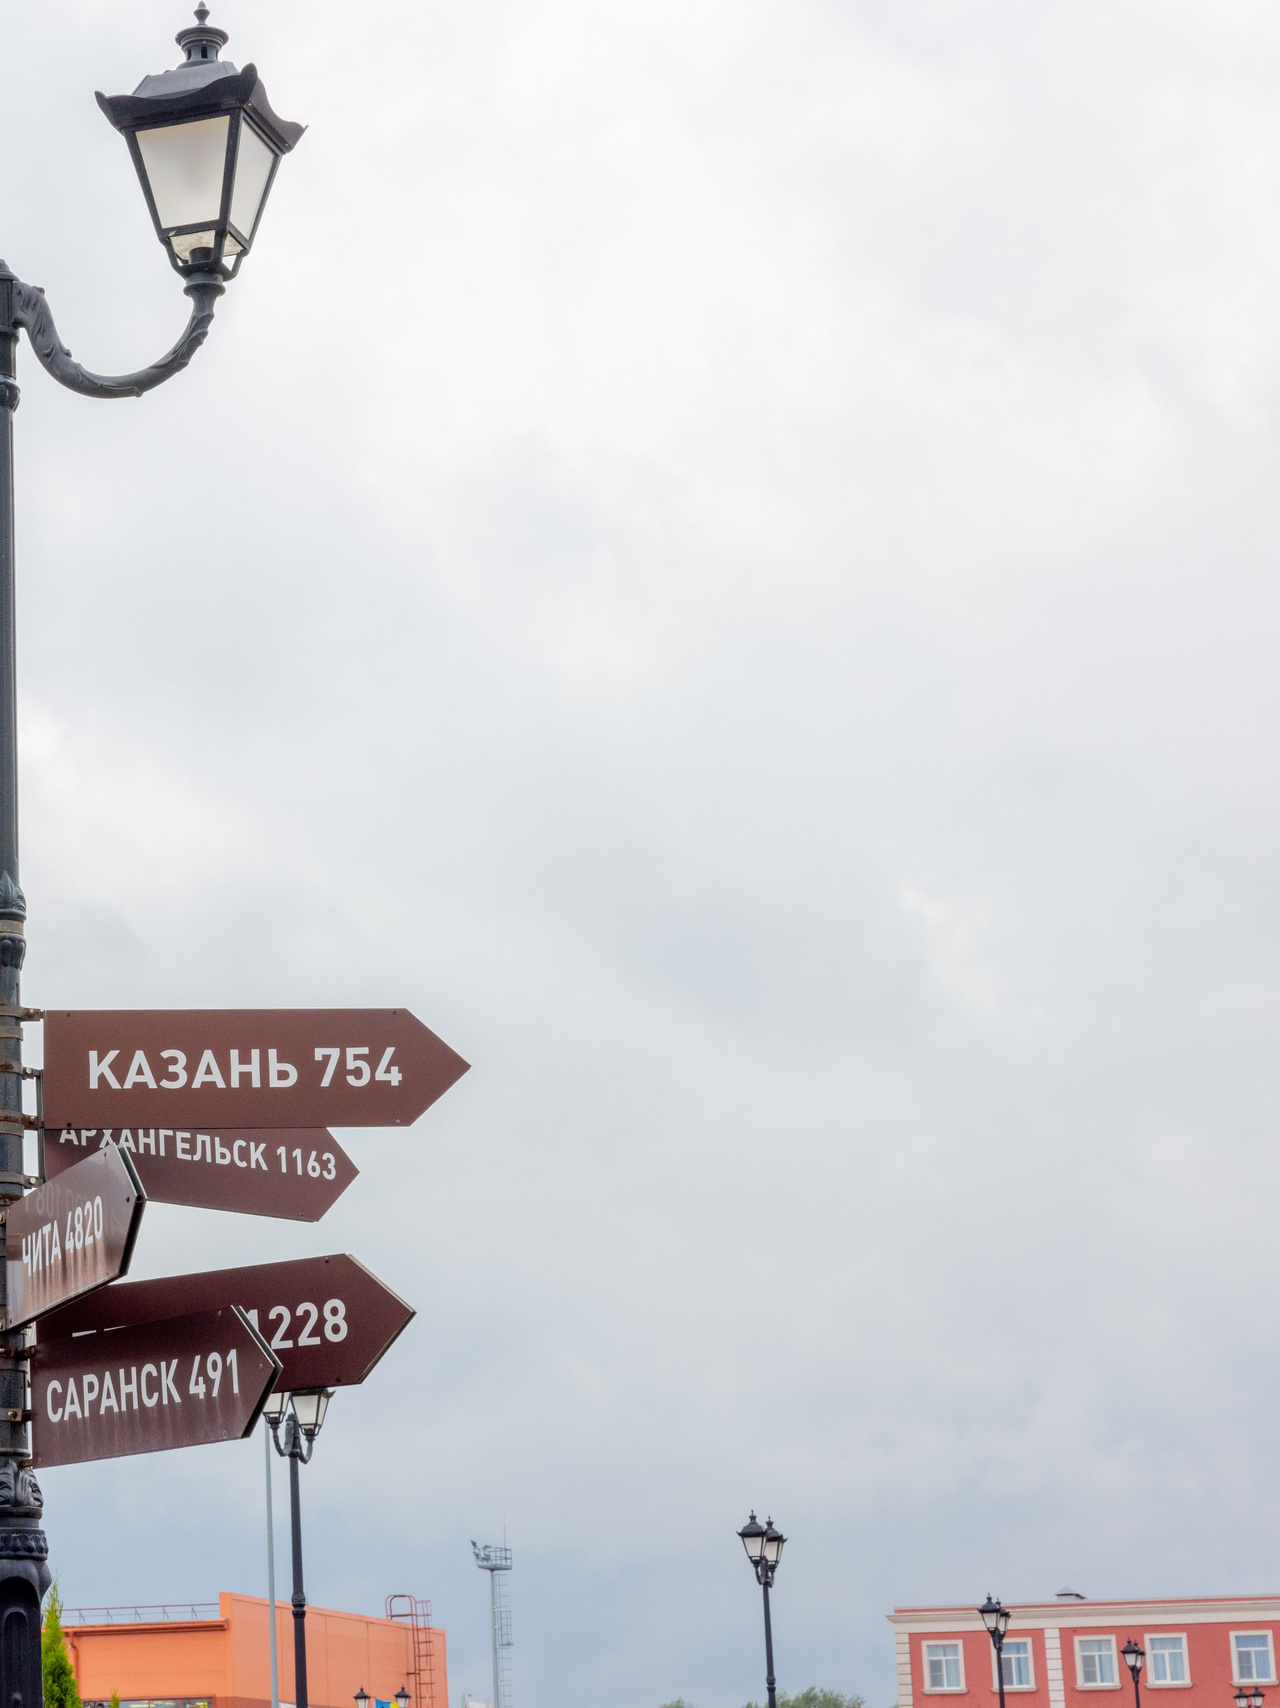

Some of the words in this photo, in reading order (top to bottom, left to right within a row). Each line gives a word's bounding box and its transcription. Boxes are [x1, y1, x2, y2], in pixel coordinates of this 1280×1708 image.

[88, 1048, 298, 1089] КАЗАНЬ
[314, 1046, 403, 1088] 754
[276, 1146, 337, 1180] 1163
[22, 1219, 62, 1276] ЧИТА
[65, 1195, 103, 1254] 4820
[46, 1358, 182, 1423] САРАНСК
[188, 1348, 239, 1399] 491
